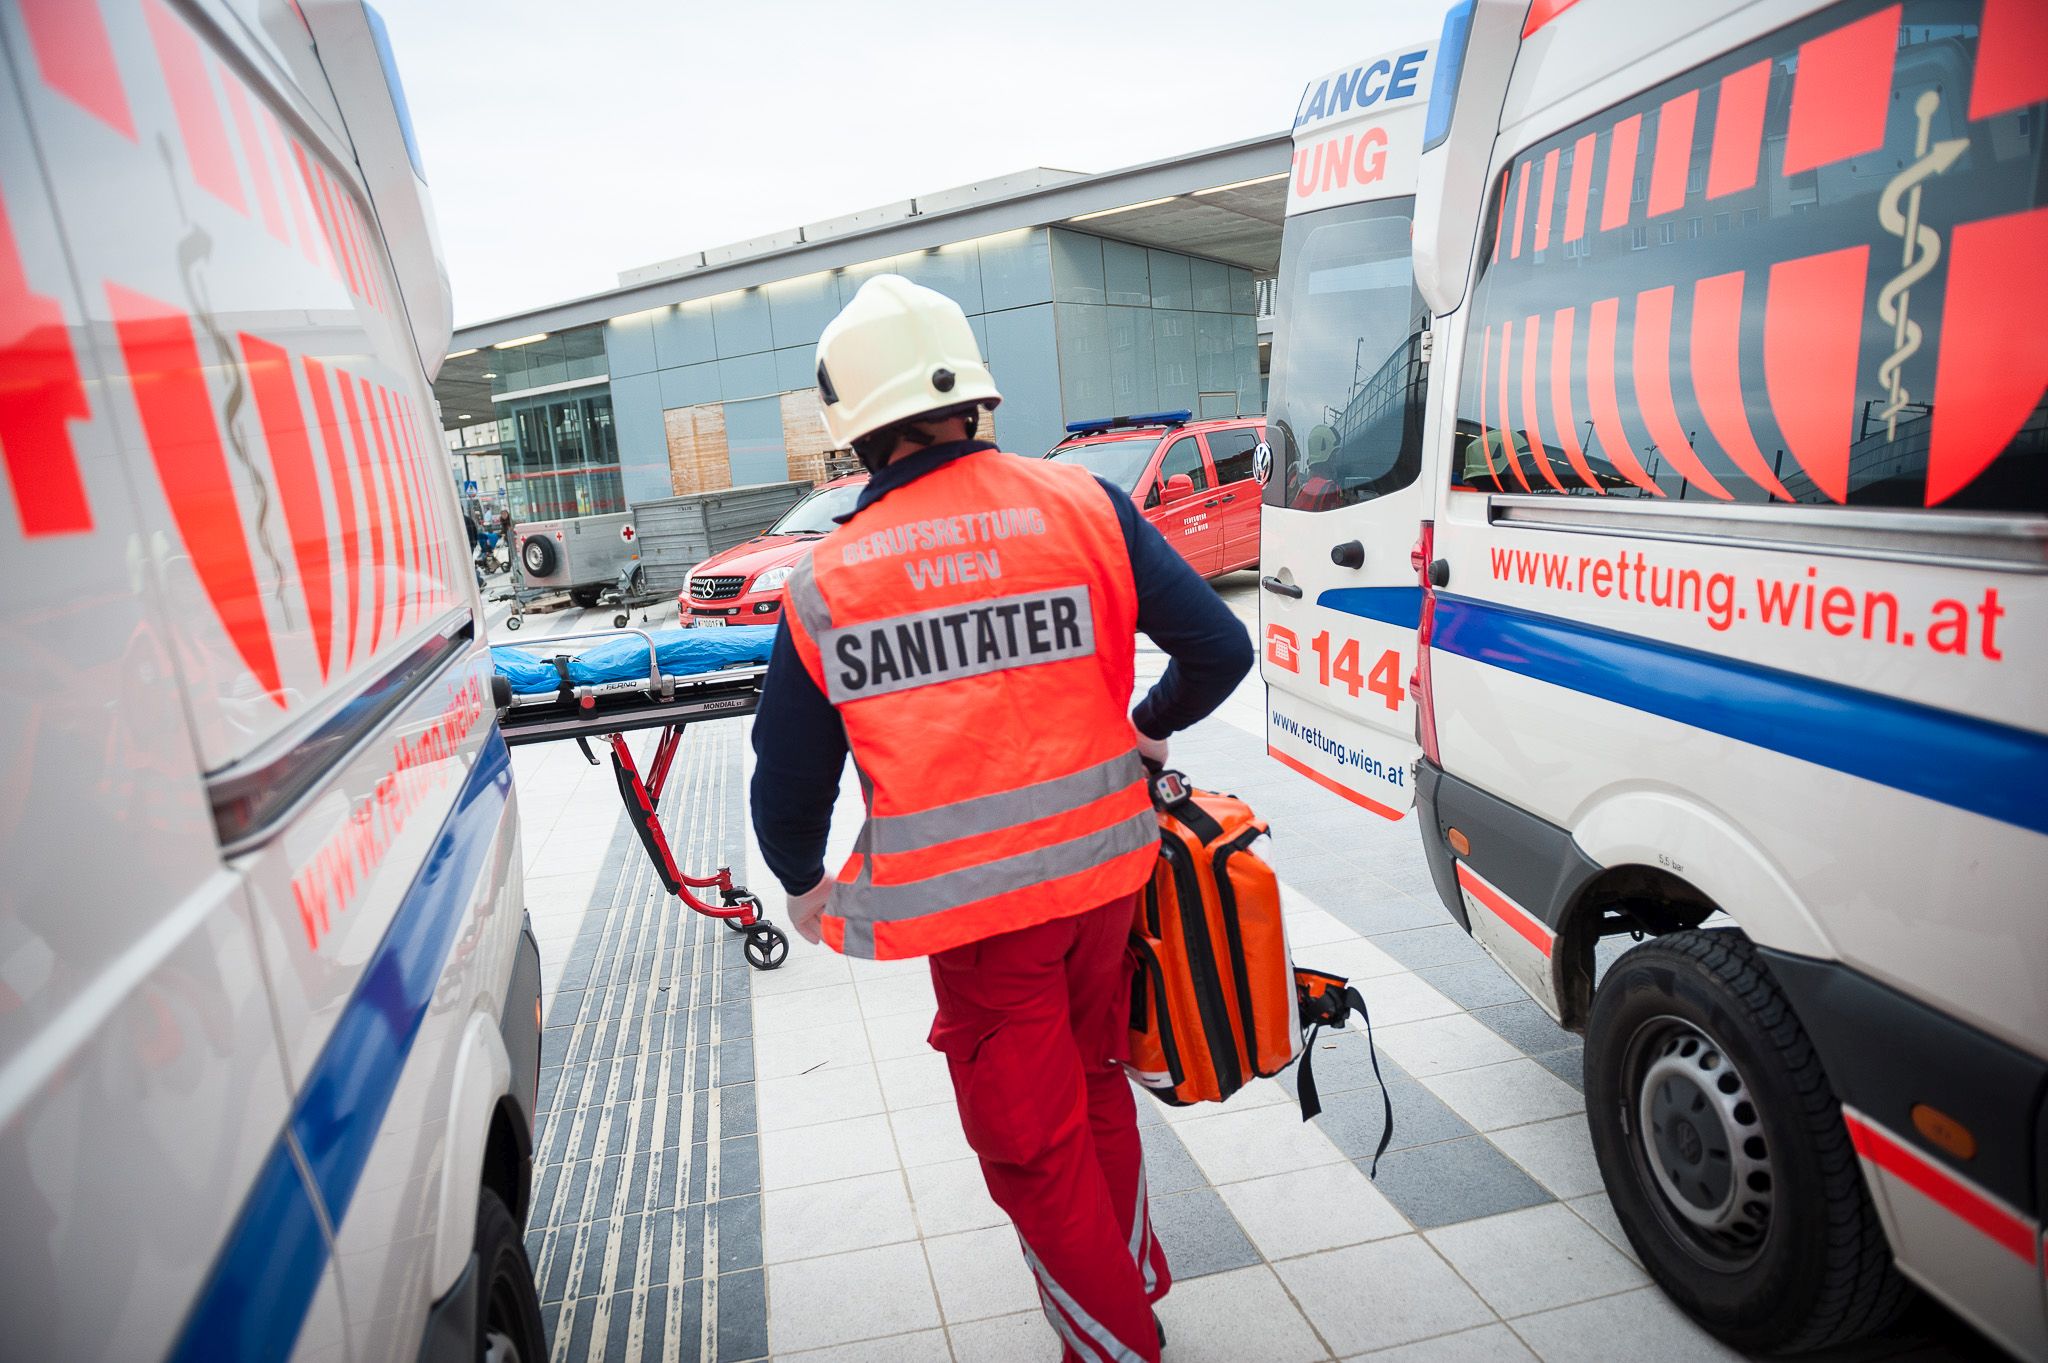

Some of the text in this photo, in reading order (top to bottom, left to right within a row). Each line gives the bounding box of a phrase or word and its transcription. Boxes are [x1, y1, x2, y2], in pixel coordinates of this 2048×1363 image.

[842, 507, 1046, 566] BERUFSRETTUNG
[904, 549, 1002, 591] WIEN
[1490, 546, 2006, 662] www.rettung.wien.at
[835, 596, 1082, 691] SANITÄTER
[1311, 629, 1405, 712] 144
[606, 681, 637, 690] FERNO
[703, 701, 735, 710] MONDIAL
[1272, 710, 1404, 787] www.rettung.wien.at
[1672, 860, 1684, 872] bar
